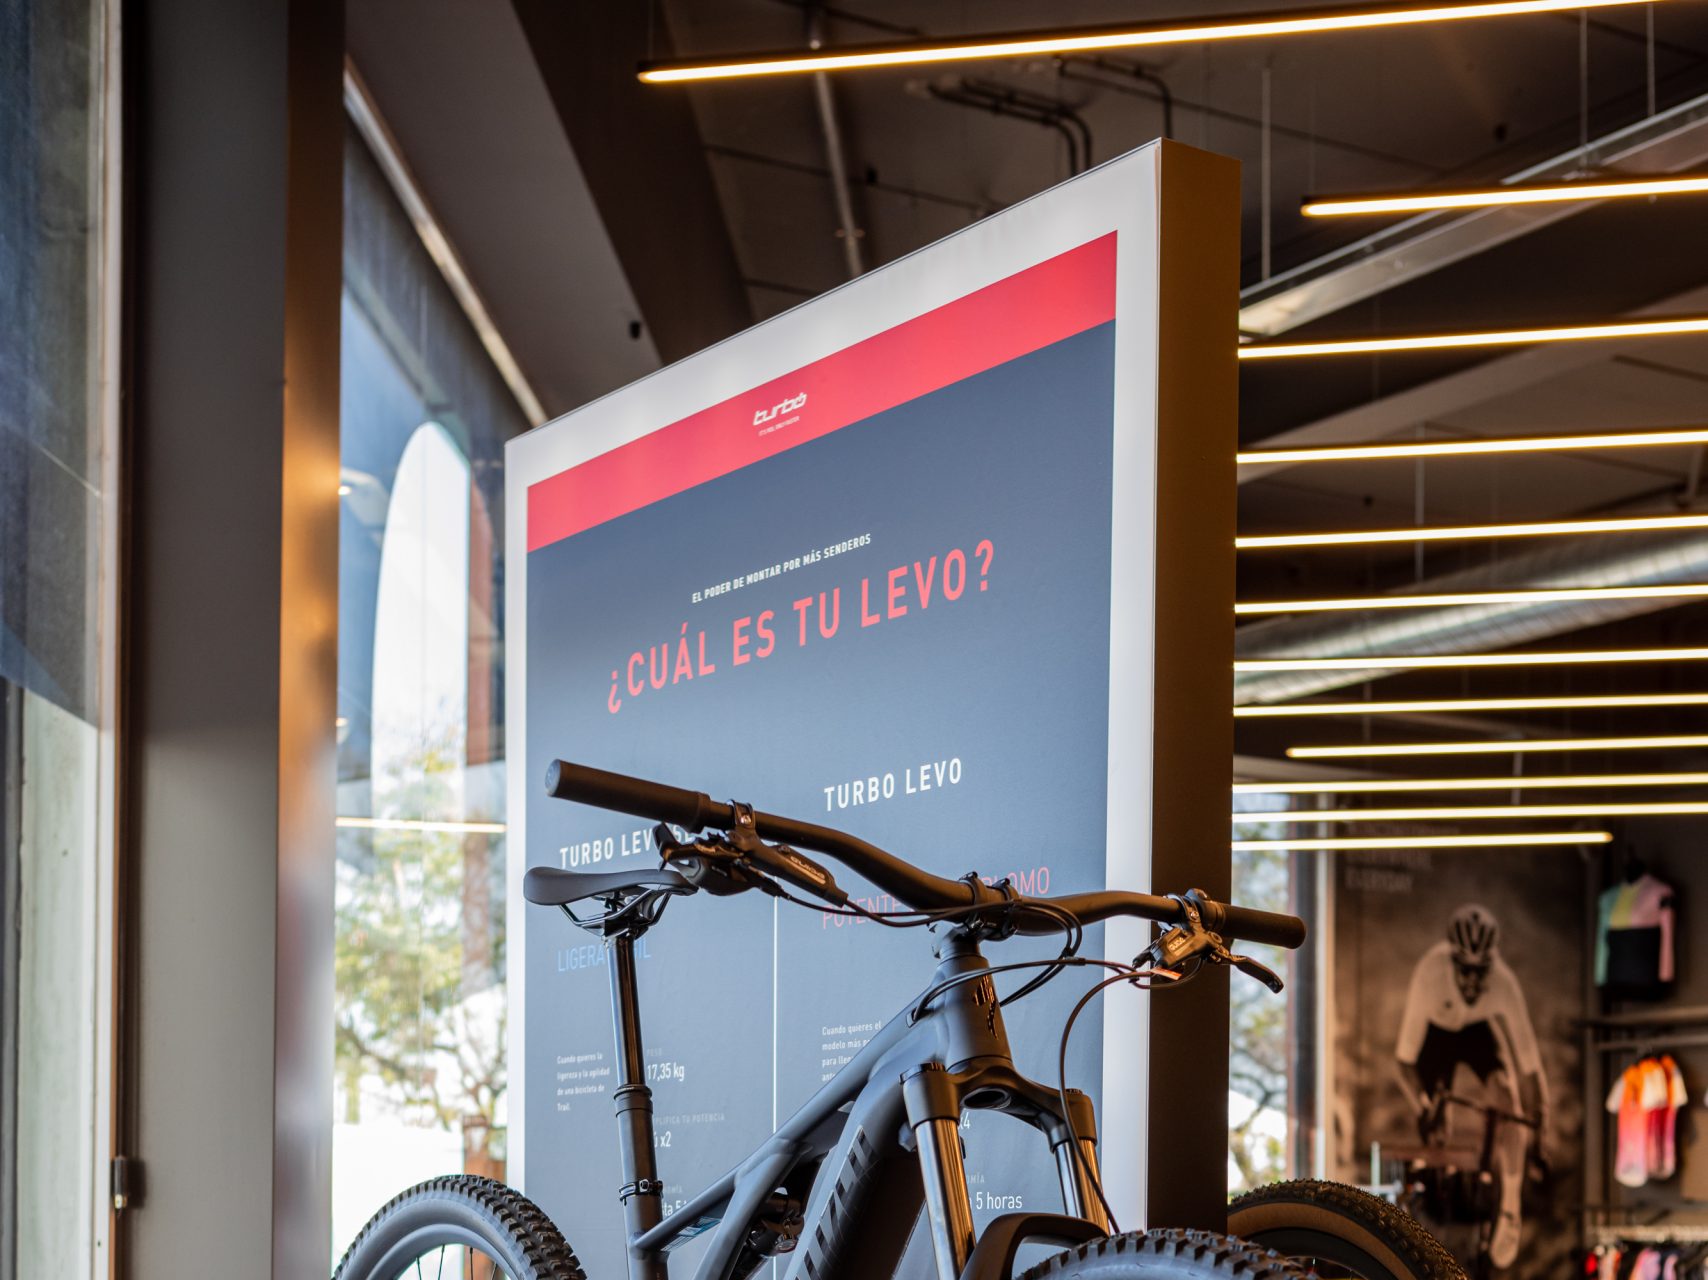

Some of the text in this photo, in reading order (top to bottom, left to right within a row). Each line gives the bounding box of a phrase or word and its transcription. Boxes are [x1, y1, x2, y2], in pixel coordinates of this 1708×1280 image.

[753, 392, 807, 426] turbo
[692, 533, 871, 604] EL PODER DE MONTAR POR MÁS SENDEROS
[607, 539, 994, 714] ¿CUÁL ES TU LEVO?
[823, 757, 962, 812] TURBO LEVO
[559, 836, 614, 869] TURBO
[621, 827, 654, 857] LEV
[557, 944, 606, 972] LIGERA
[822, 1020, 882, 1036] Cuando quieres el
[821, 1040, 846, 1051] modelo
[847, 1038, 862, 1048] más
[647, 1061, 685, 1082] 17,35 kg
[821, 1057, 837, 1069] para
[660, 1130, 672, 1148] x2
[976, 1191, 1023, 1210] 5 horas
